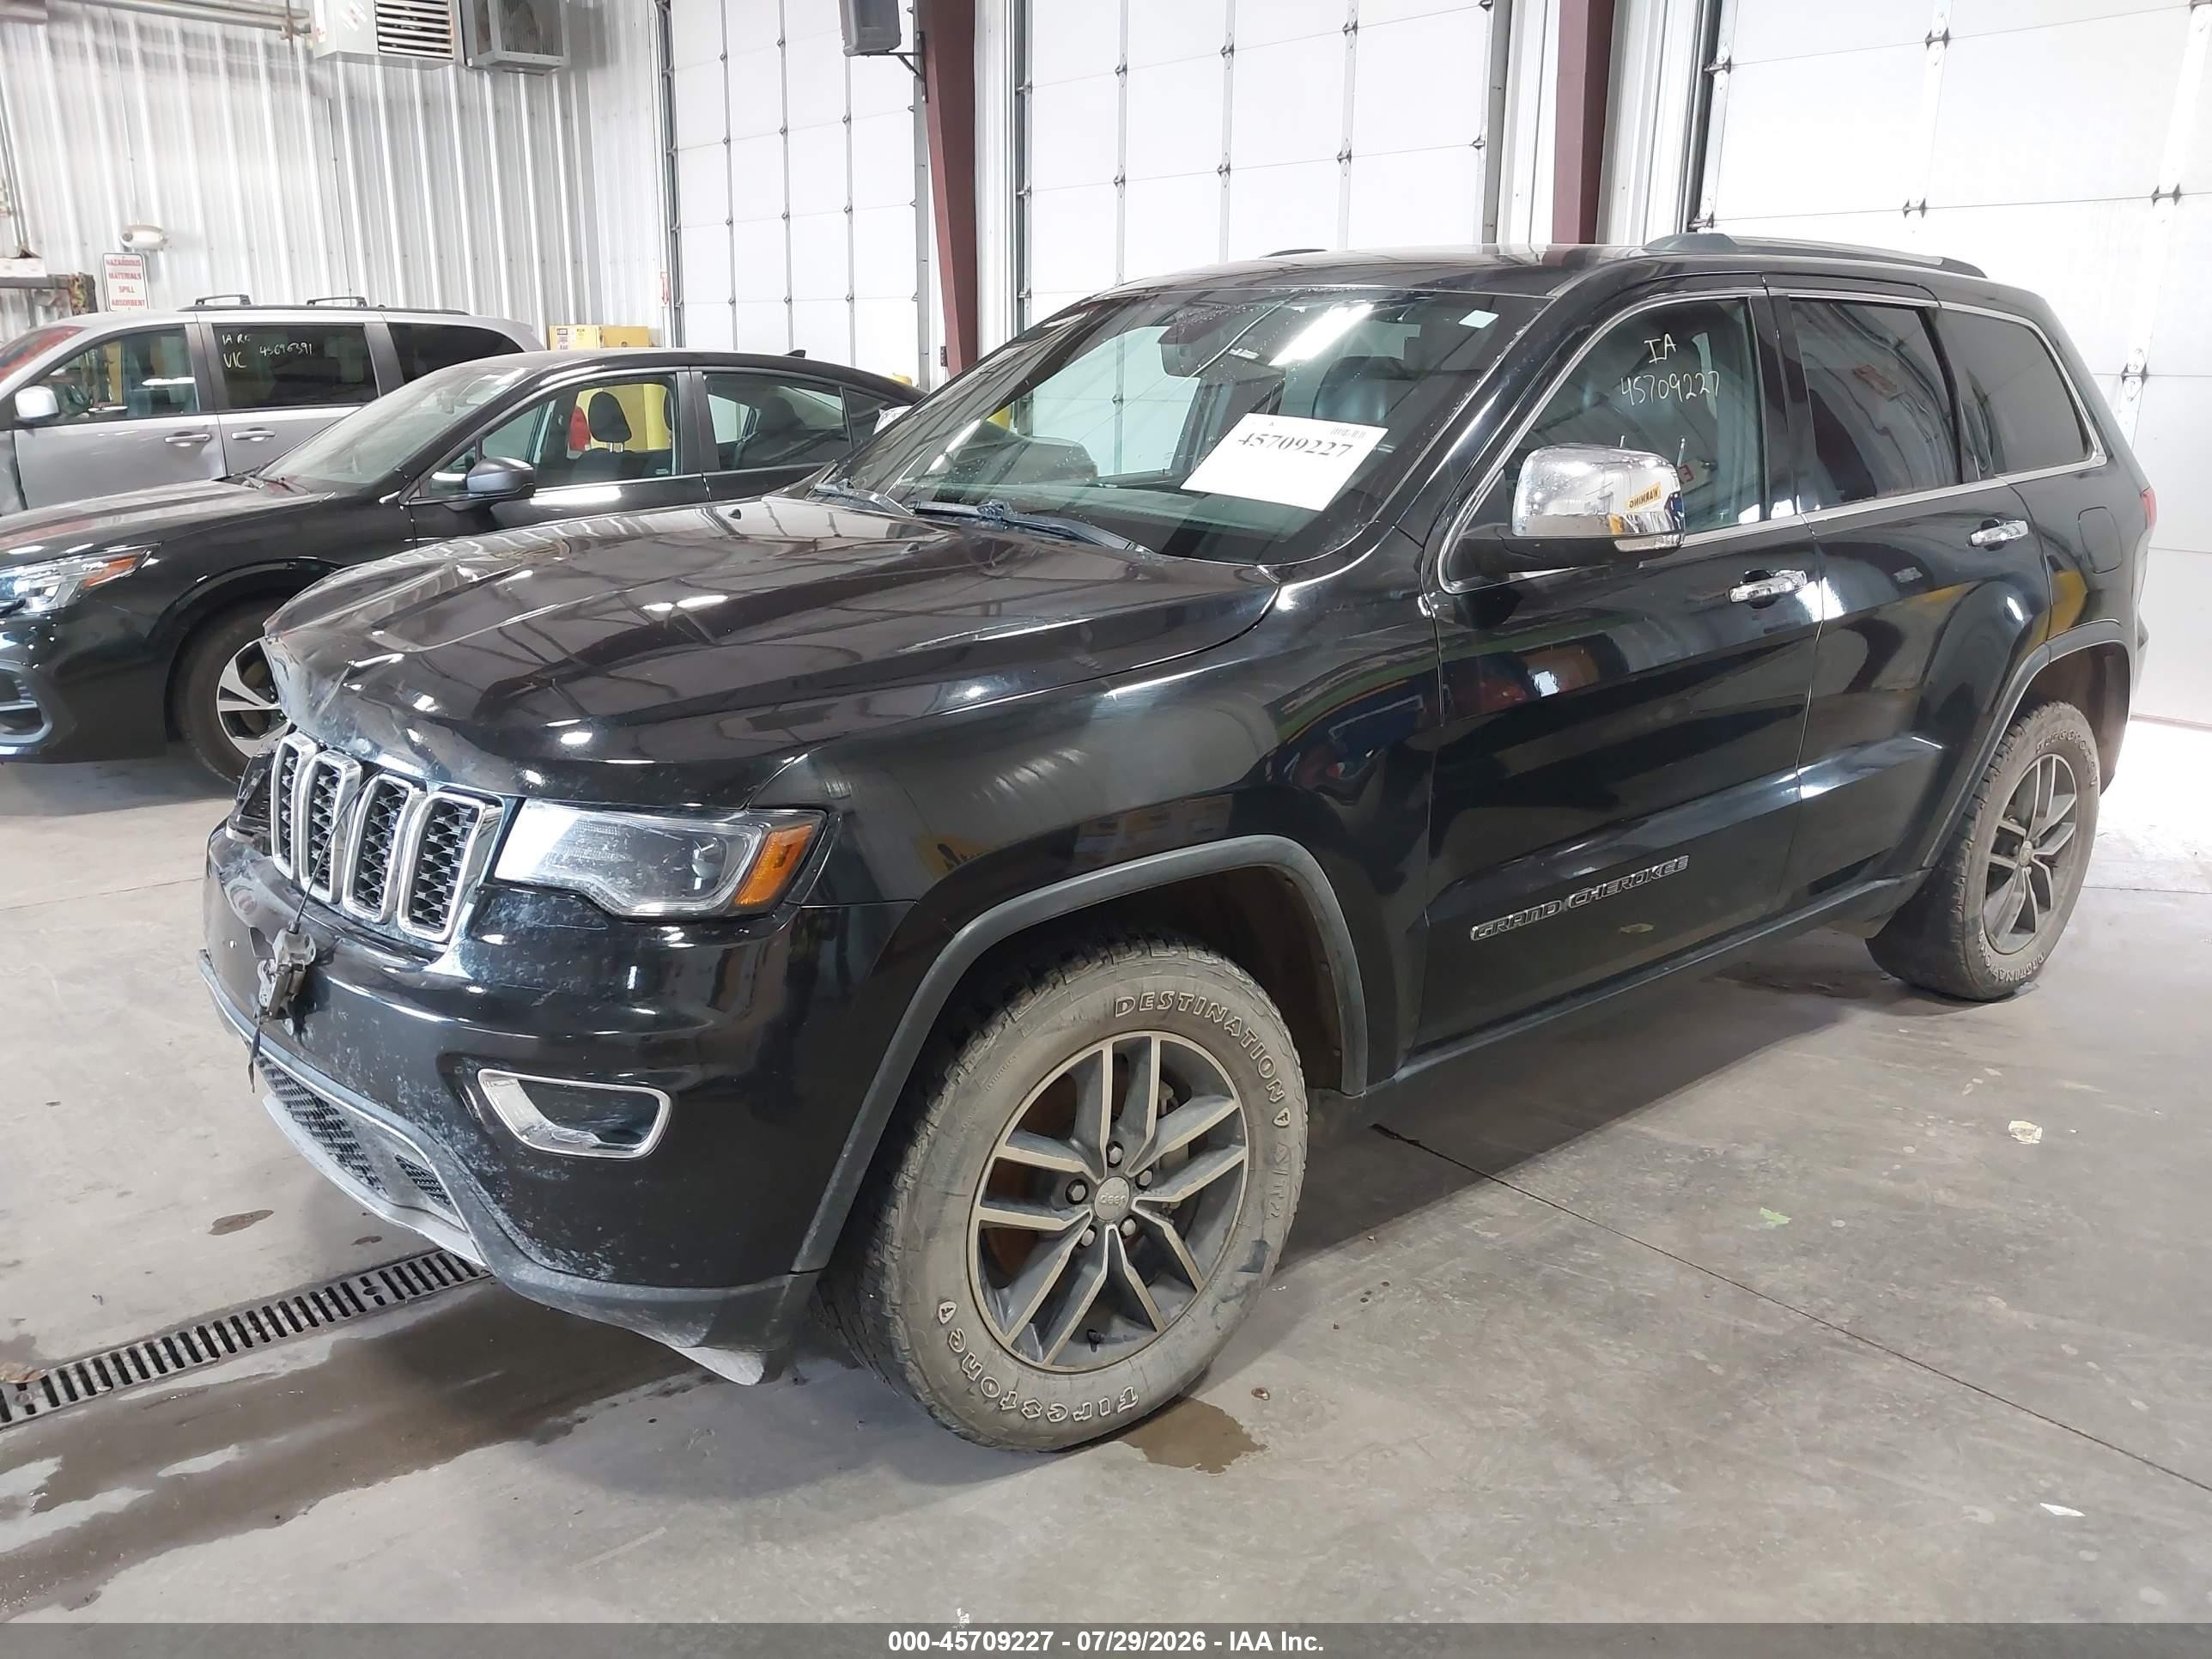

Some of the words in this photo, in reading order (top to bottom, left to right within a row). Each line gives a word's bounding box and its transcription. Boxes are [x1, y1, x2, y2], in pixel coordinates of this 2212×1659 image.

[223, 351, 246, 368] VIC
[1644, 333, 1676, 364] IA
[1620, 370, 1719, 405] 45709227
[1237, 432, 1354, 459] 45709227
[1471, 900, 1563, 941] GRAND
[1567, 854, 1690, 909] CHEROKEE
[1115, 990, 1285, 1103] DESTINATION
